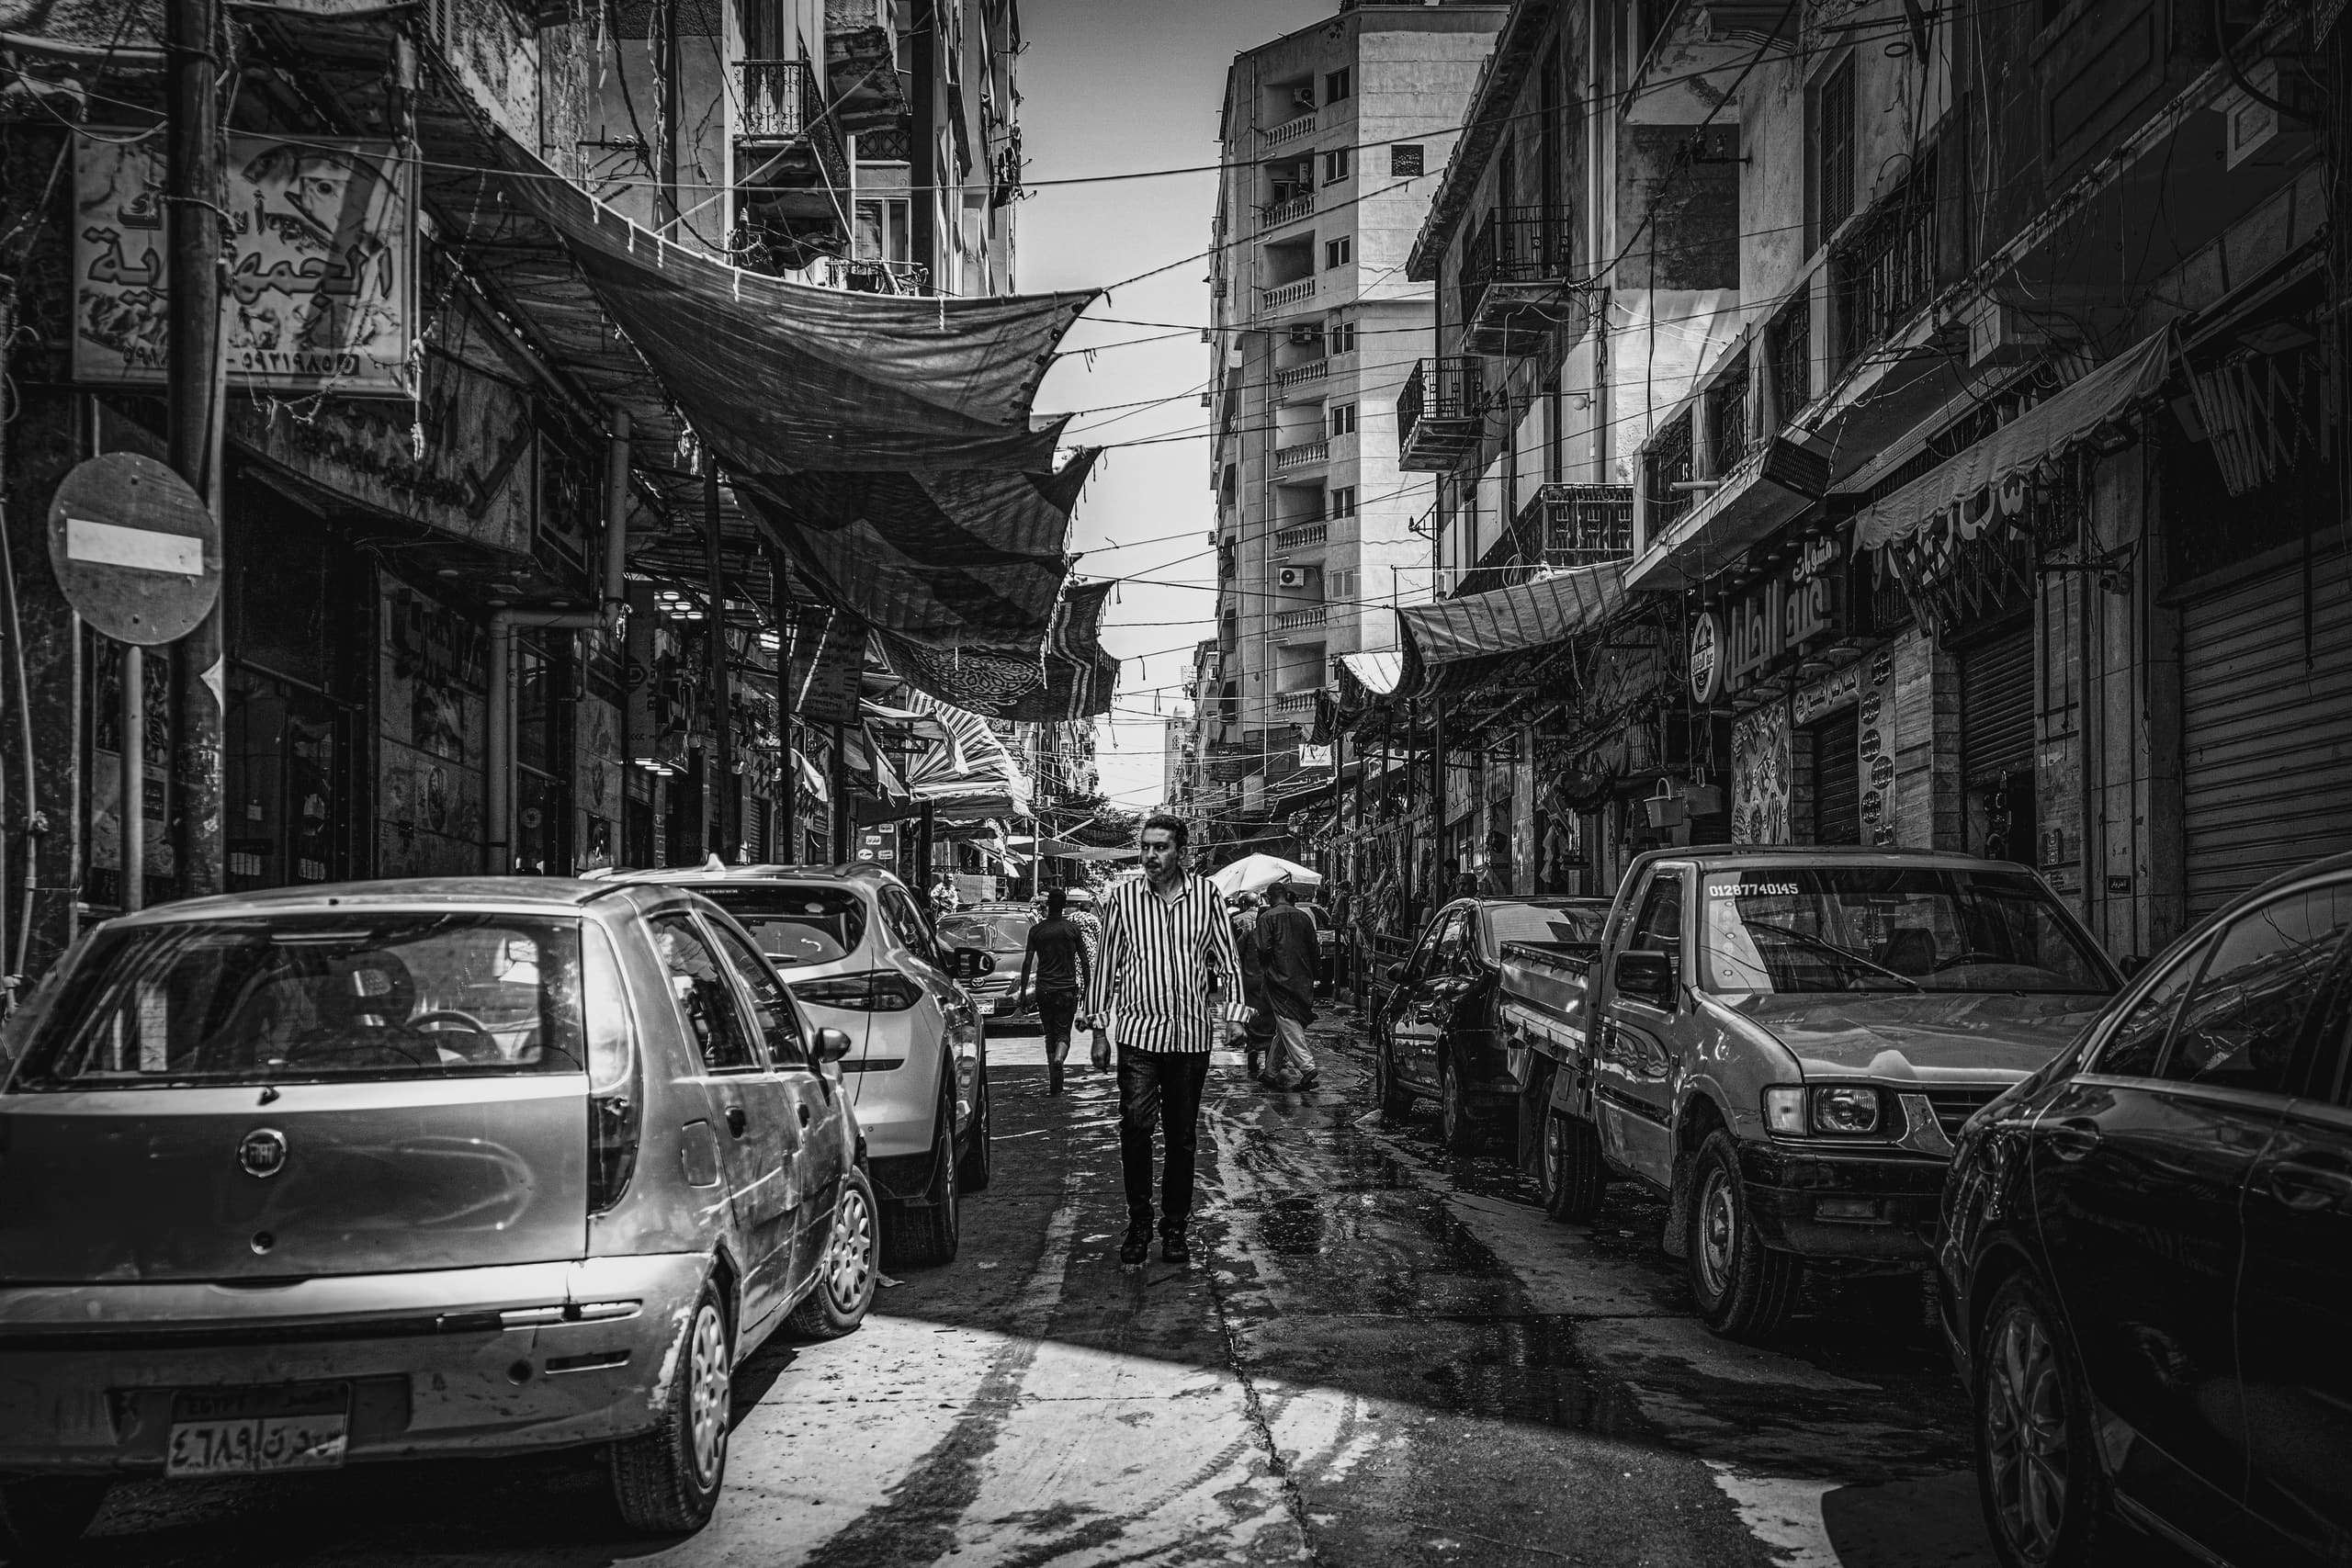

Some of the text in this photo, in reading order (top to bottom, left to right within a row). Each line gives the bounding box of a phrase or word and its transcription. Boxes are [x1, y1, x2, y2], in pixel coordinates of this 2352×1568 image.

[1792, 536, 1832, 584] مشويات
[1709, 883, 1799, 897] 01287740145
[189, 1394, 246, 1415] EGYPT
